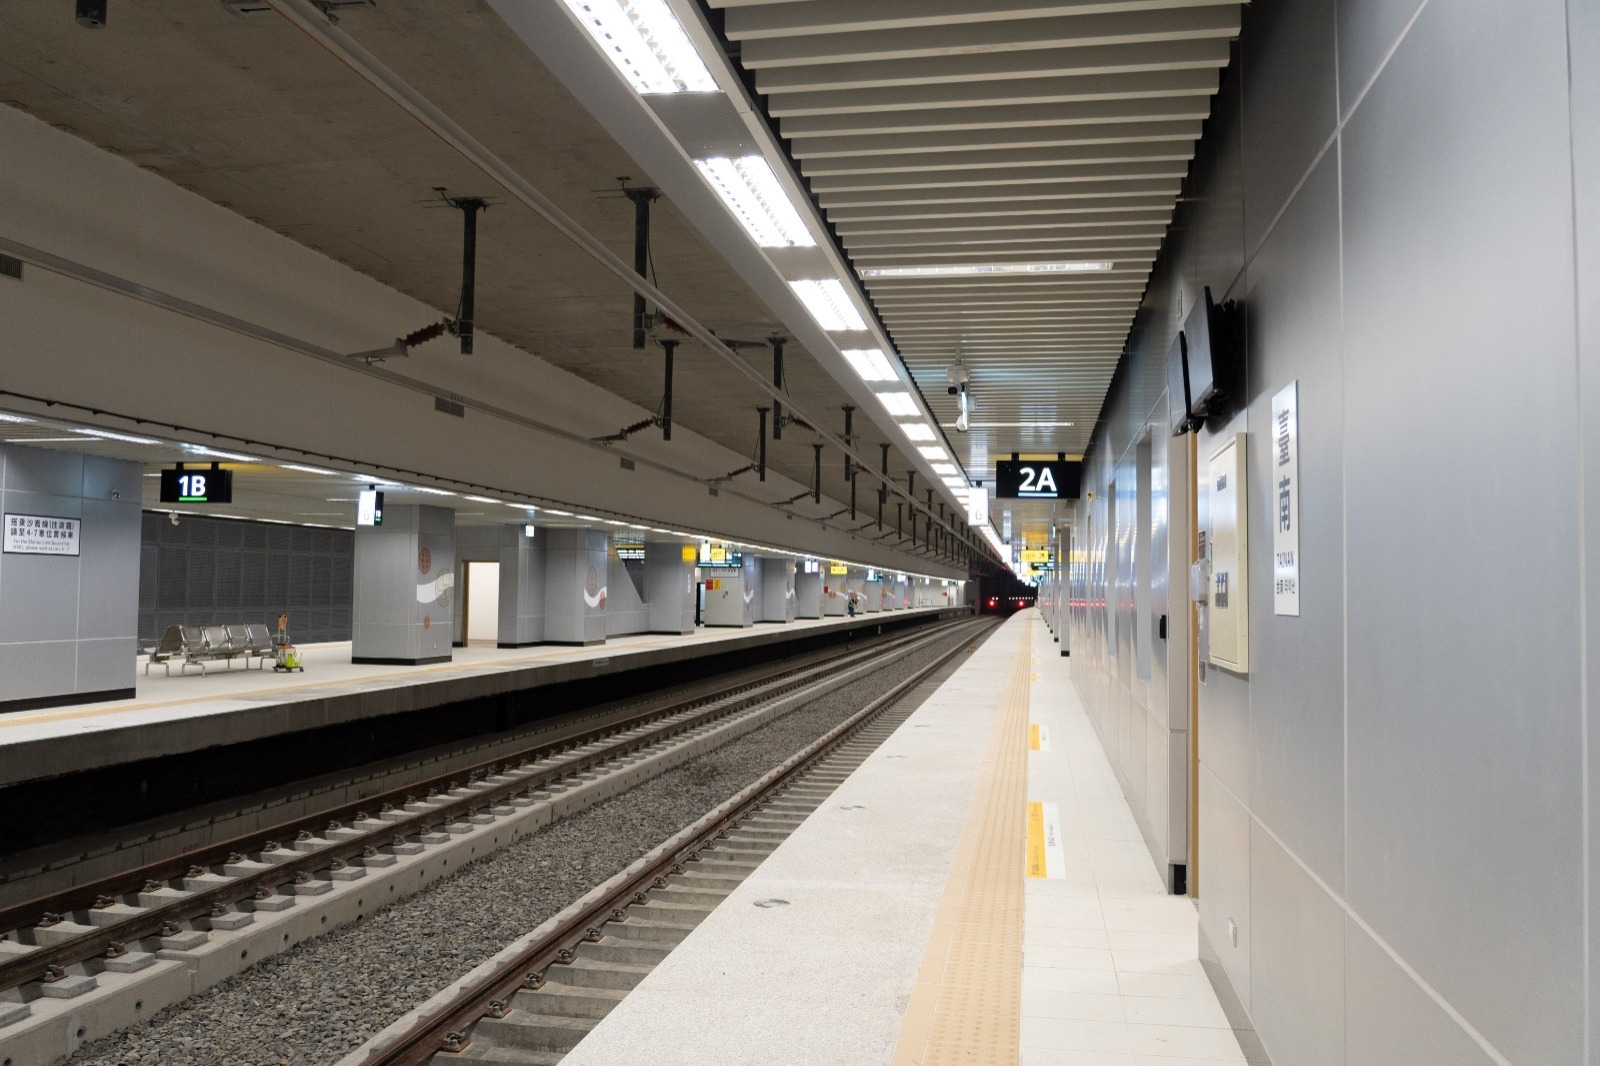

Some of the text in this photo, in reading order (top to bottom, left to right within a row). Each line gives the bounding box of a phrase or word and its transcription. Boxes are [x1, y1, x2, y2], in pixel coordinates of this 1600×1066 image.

[1018, 466, 1057, 492] 2A
[1278, 408, 1290, 533] 臺南
[178, 475, 206, 497] 1B
